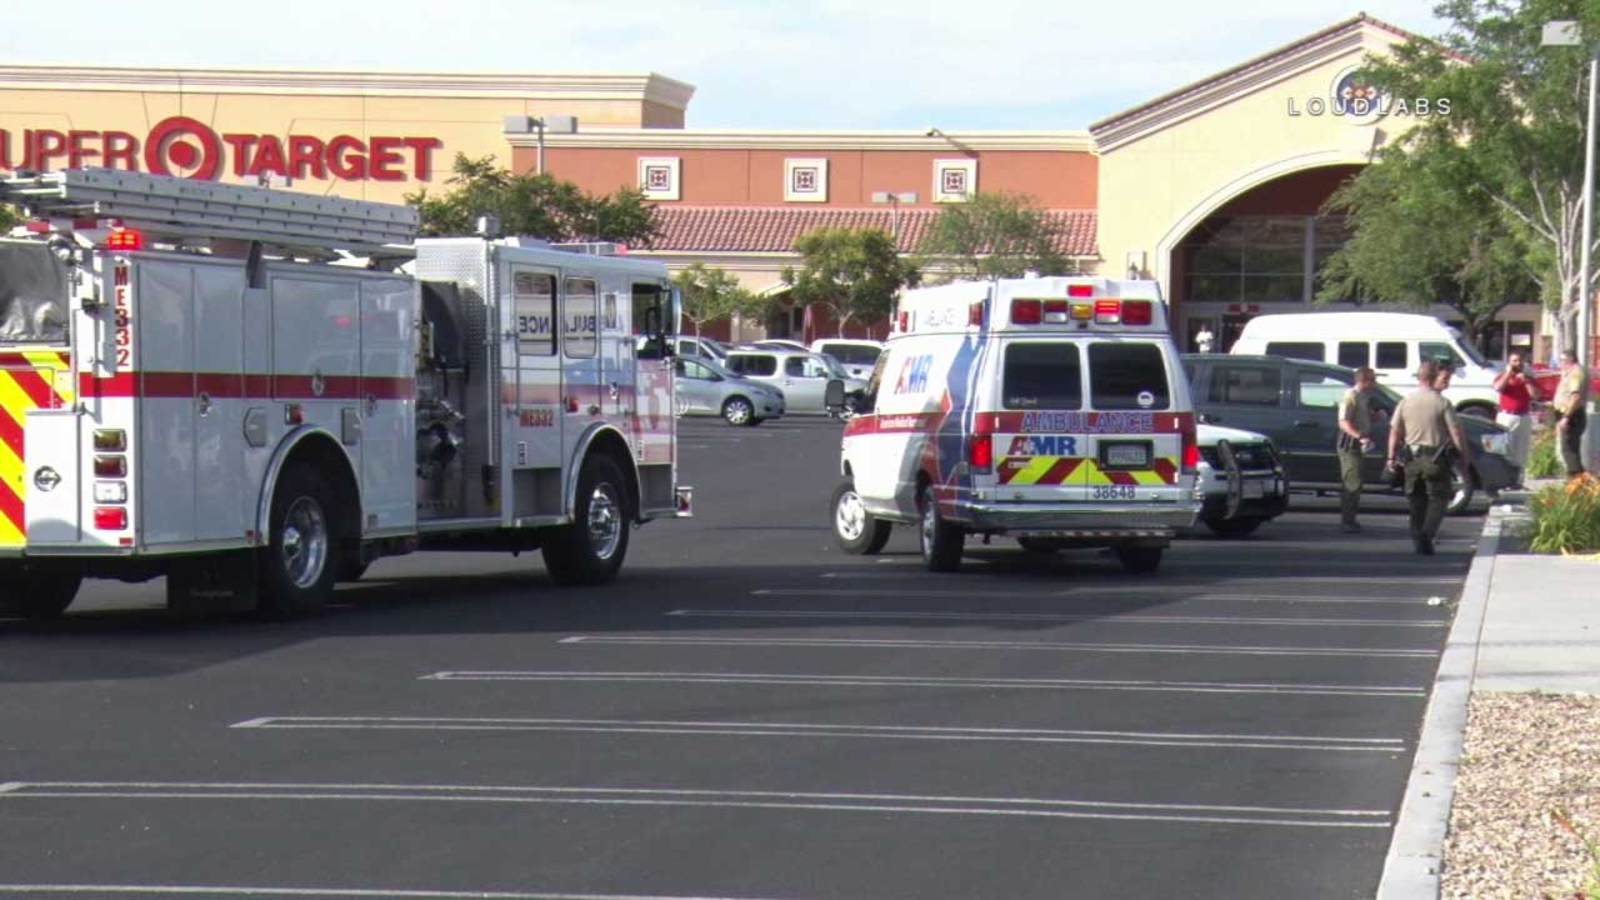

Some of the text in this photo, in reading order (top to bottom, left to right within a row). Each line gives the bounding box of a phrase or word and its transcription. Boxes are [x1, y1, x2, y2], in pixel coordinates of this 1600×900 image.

[222, 133, 443, 181] TARGET
[115, 266, 130, 367] ME332
[894, 353, 933, 394] AMR
[1021, 411, 1154, 433] AMBULANCE
[1008, 436, 1077, 456] AMR
[1093, 485, 1136, 499] 38648
